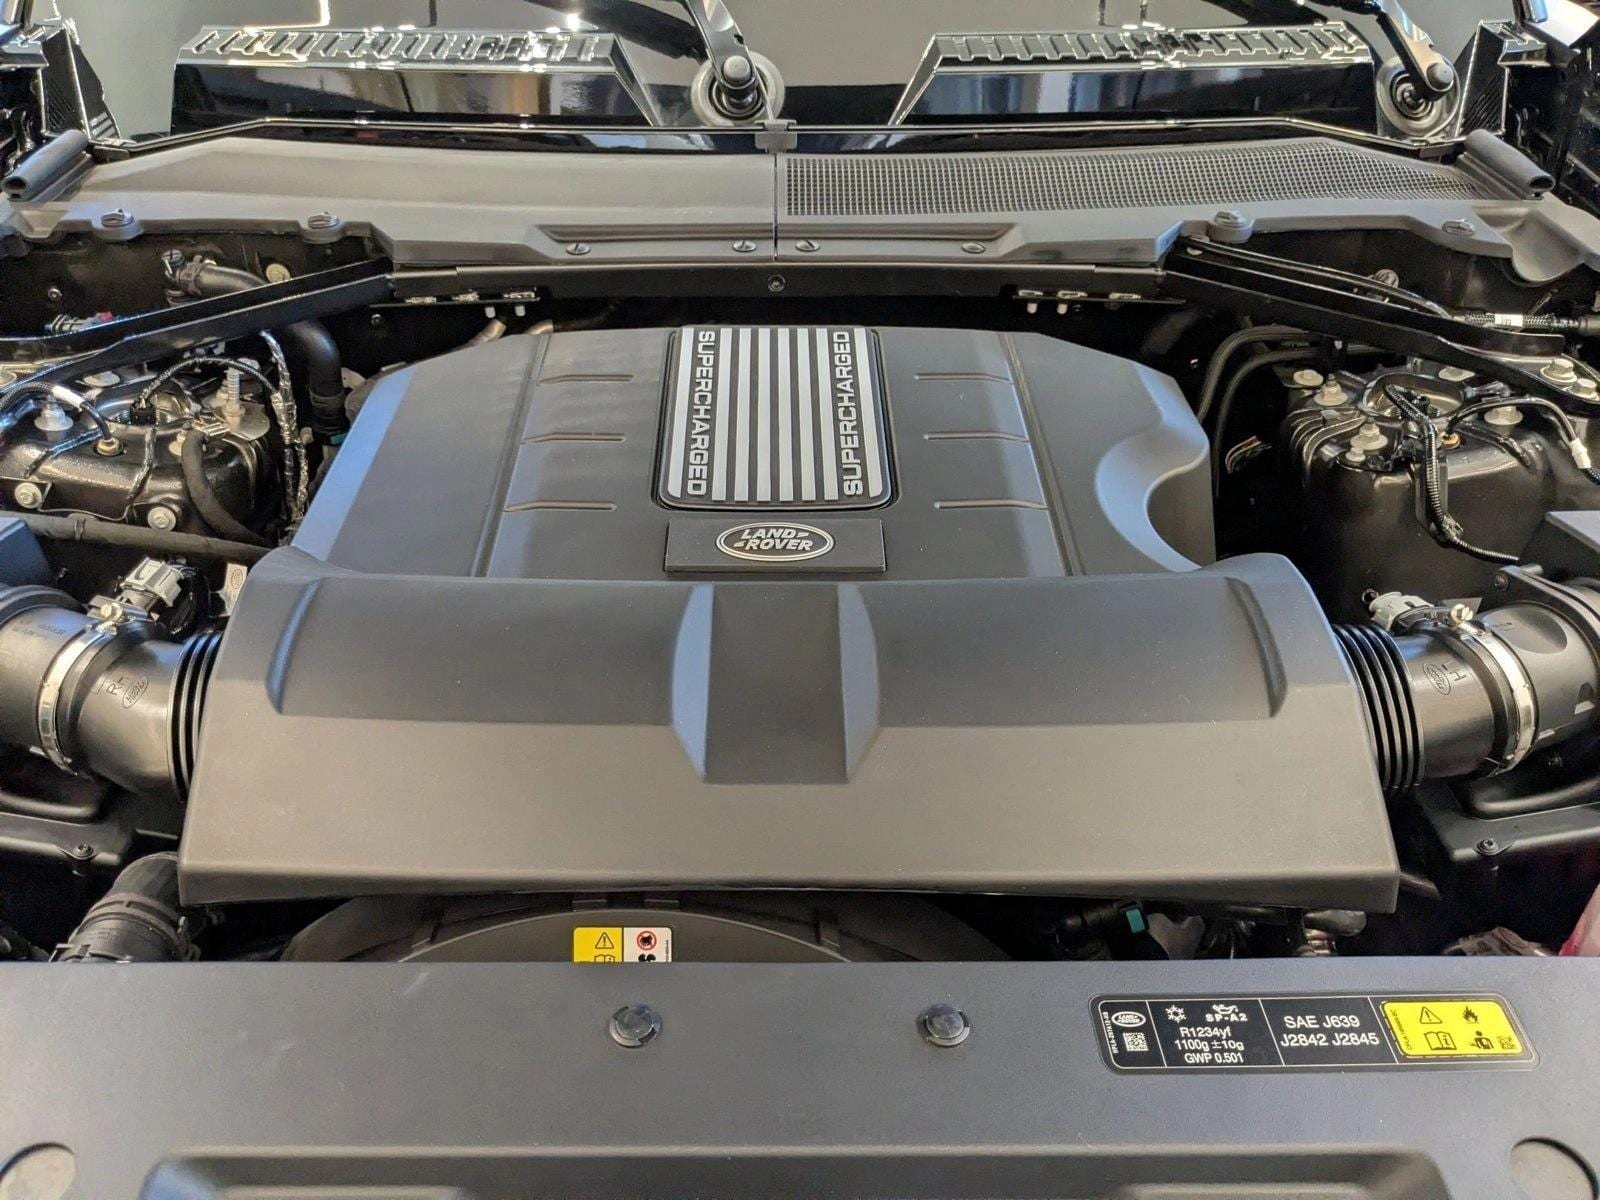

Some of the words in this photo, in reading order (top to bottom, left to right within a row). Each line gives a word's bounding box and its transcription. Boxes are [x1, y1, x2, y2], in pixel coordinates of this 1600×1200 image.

[687, 330, 716, 496] SUPERCHARGED
[833, 331, 864, 496] SUPERCHARGED
[741, 528, 797, 540] LAND
[745, 538, 814, 551] ROVER
[1205, 1012, 1248, 1022] SP-A2
[1284, 1015, 1320, 1029] SAE
[1322, 1015, 1360, 1028] J639
[1179, 1025, 1232, 1039] R1234yf
[1174, 1039, 1210, 1052] 1100g
[1211, 1039, 1245, 1051] ±10g
[1280, 1033, 1329, 1047] J2842
[1331, 1032, 1380, 1046] J2845
[1184, 1052, 1212, 1063] GWP
[1214, 1052, 1244, 1063] 0.501
